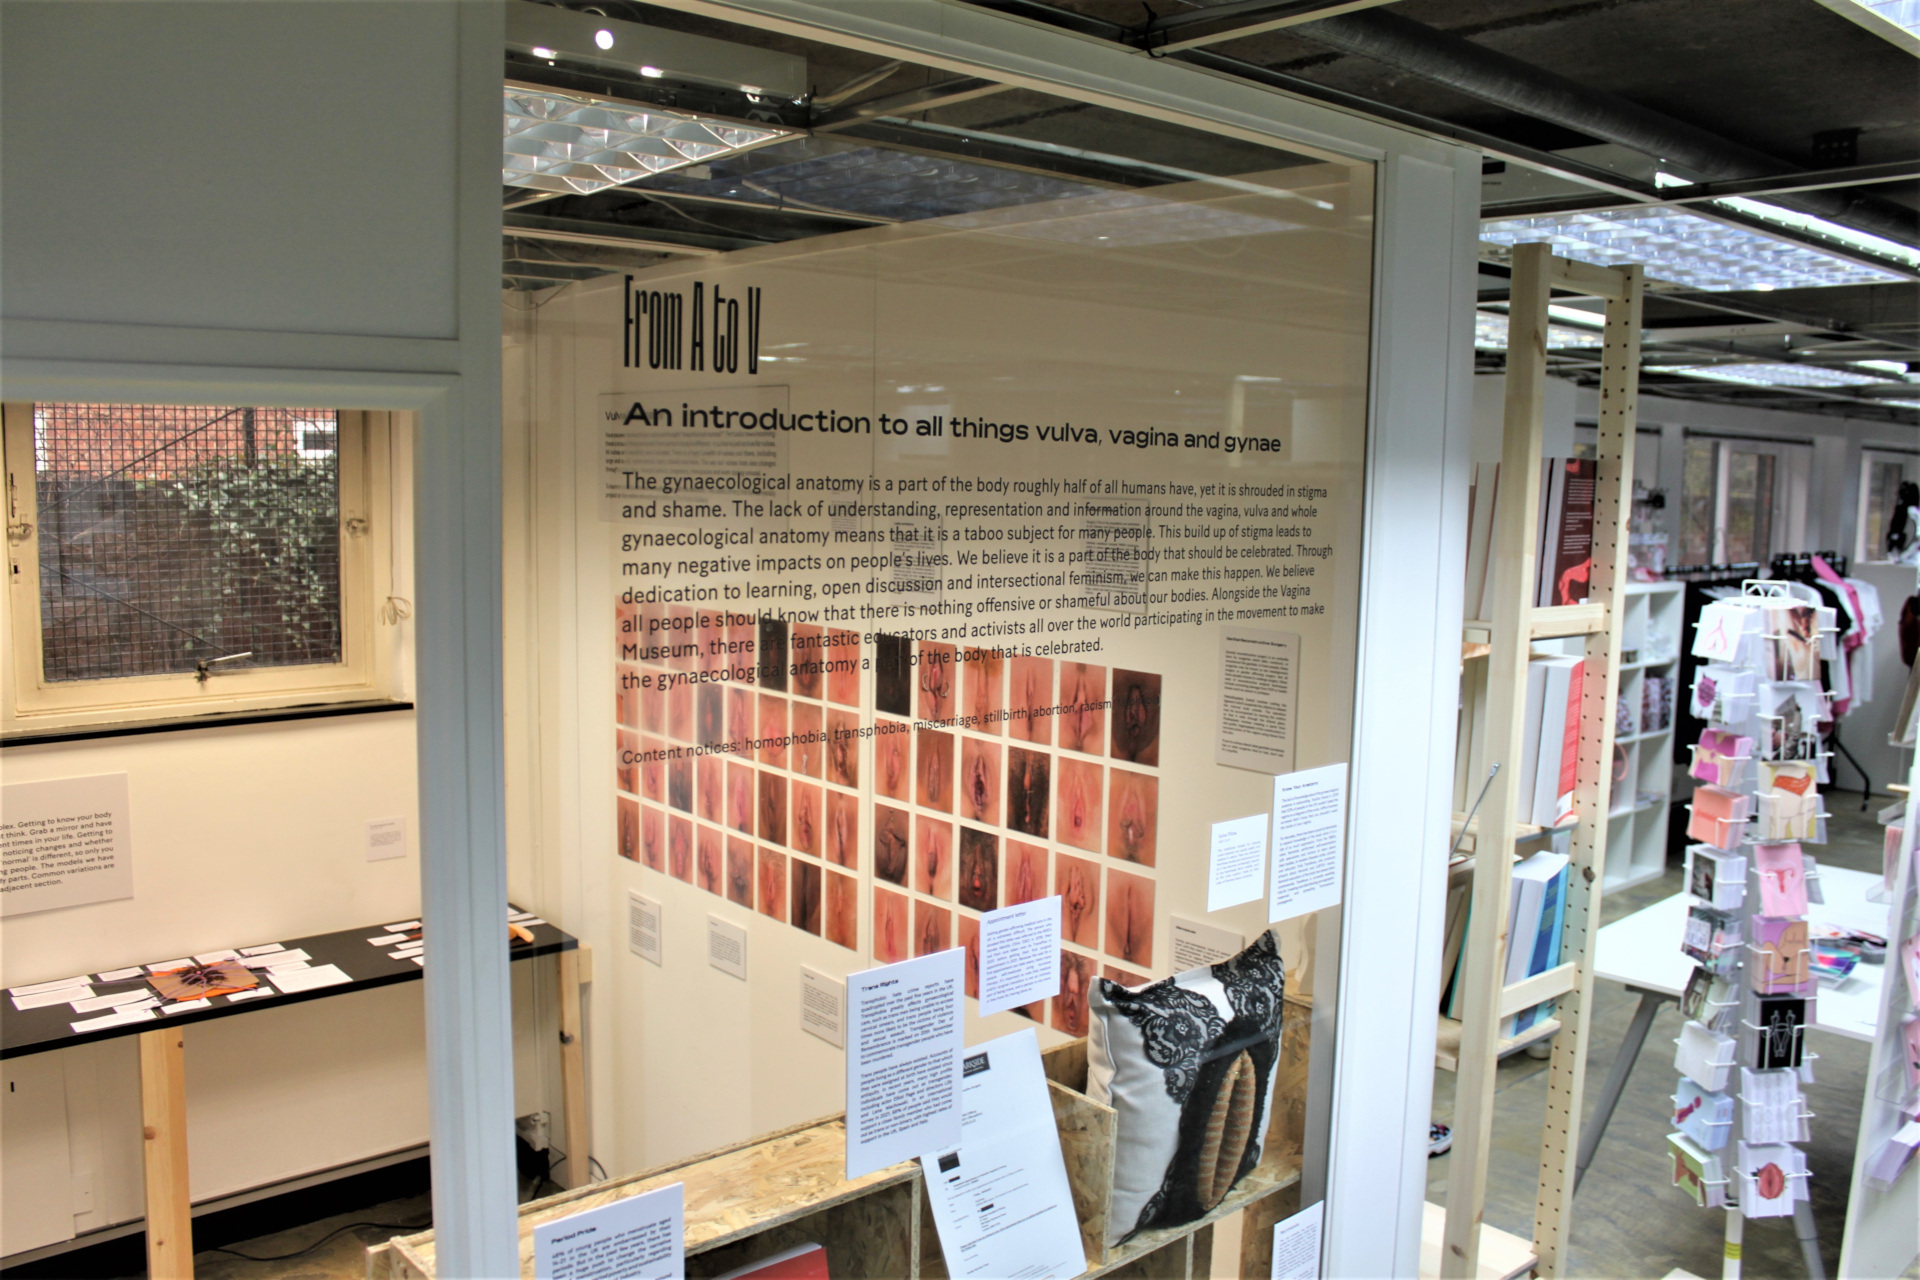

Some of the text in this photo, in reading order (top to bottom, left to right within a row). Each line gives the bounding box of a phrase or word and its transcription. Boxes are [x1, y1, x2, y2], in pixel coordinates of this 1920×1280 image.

[624, 275, 761, 374] From A to V
[623, 402, 672, 426] An
[682, 403, 871, 433] introduction
[879, 413, 908, 435] to
[915, 415, 943, 437] all
[949, 416, 1029, 443] things
[1036, 422, 1102, 447] vulva,
[1109, 427, 1178, 448] vagina
[1184, 431, 1219, 449] and
[1224, 435, 1281, 453] gynae
[622, 472, 1327, 500] The gynaecological anatomy part the body roughly half humans have, yet shrouded stigma
[622, 500, 656, 518] and
[663, 500, 726, 517] shame.
[732, 501, 763, 517] The
[769, 500, 802, 516] lack
[828, 501, 940, 520] understanding,
[946, 503, 1042, 520] representation
[1074, 503, 1141, 517] information
[1145, 504, 1183, 516] around
[1207, 505, 1241, 520] vagina,
[1244, 506, 1268, 517] vulva
[1272, 506, 1288, 517] and
[1292, 506, 1317, 517] whole
[622, 525, 1300, 551] gynaecological anatomy means that taboo subject many people. This build stigma leads
[622, 544, 1332, 578] many negative impacts people's lives. believe part body that should celebrated. Through
[622, 564, 1314, 604] dedication learning, open discussion intersectional feminism, make this happen. believe
[622, 584, 1310, 636] all people should know that there nothing offensive shameful about bodies. Alongside Vagina
[623, 643, 704, 661] Museum,
[710, 638, 754, 655] there
[791, 632, 859, 649] fantastic
[864, 627, 937, 642] educators
[941, 623, 966, 640] and
[971, 618, 1025, 638] activists
[1048, 619, 1074, 633] over
[1100, 614, 1131, 628] world
[1135, 607, 1202, 629] participating
[1237, 605, 1286, 619] movement
[1301, 603, 1324, 616] make
[622, 672, 650, 690] the
[657, 665, 784, 690] gynaecological
[789, 658, 857, 676] anatomy
[928, 649, 950, 664] the
[955, 644, 987, 663] body
[991, 645, 1018, 659] that
[1035, 637, 1104, 656] celebrated.
[622, 744, 682, 765] Content
[687, 740, 741, 757] notices:
[834, 723, 910, 740] transphobia,
[914, 714, 981, 731] miscarriage,
[1033, 701, 1078, 719] abortion,
[18, 820, 46, 828] Getting
[77, 814, 93, 822] your
[30, 827, 48, 835] Grab
[3, 848, 33, 856] noticing
[36, 844, 66, 852] changes
[85, 837, 113, 845] whether
[44, 836, 60, 844] your
[76, 830, 103, 838] Getting
[31, 870, 65, 879] Common
[67, 865, 102, 873] variations
[57, 858, 83, 866] models
[0, 883, 32, 892] adjacent
